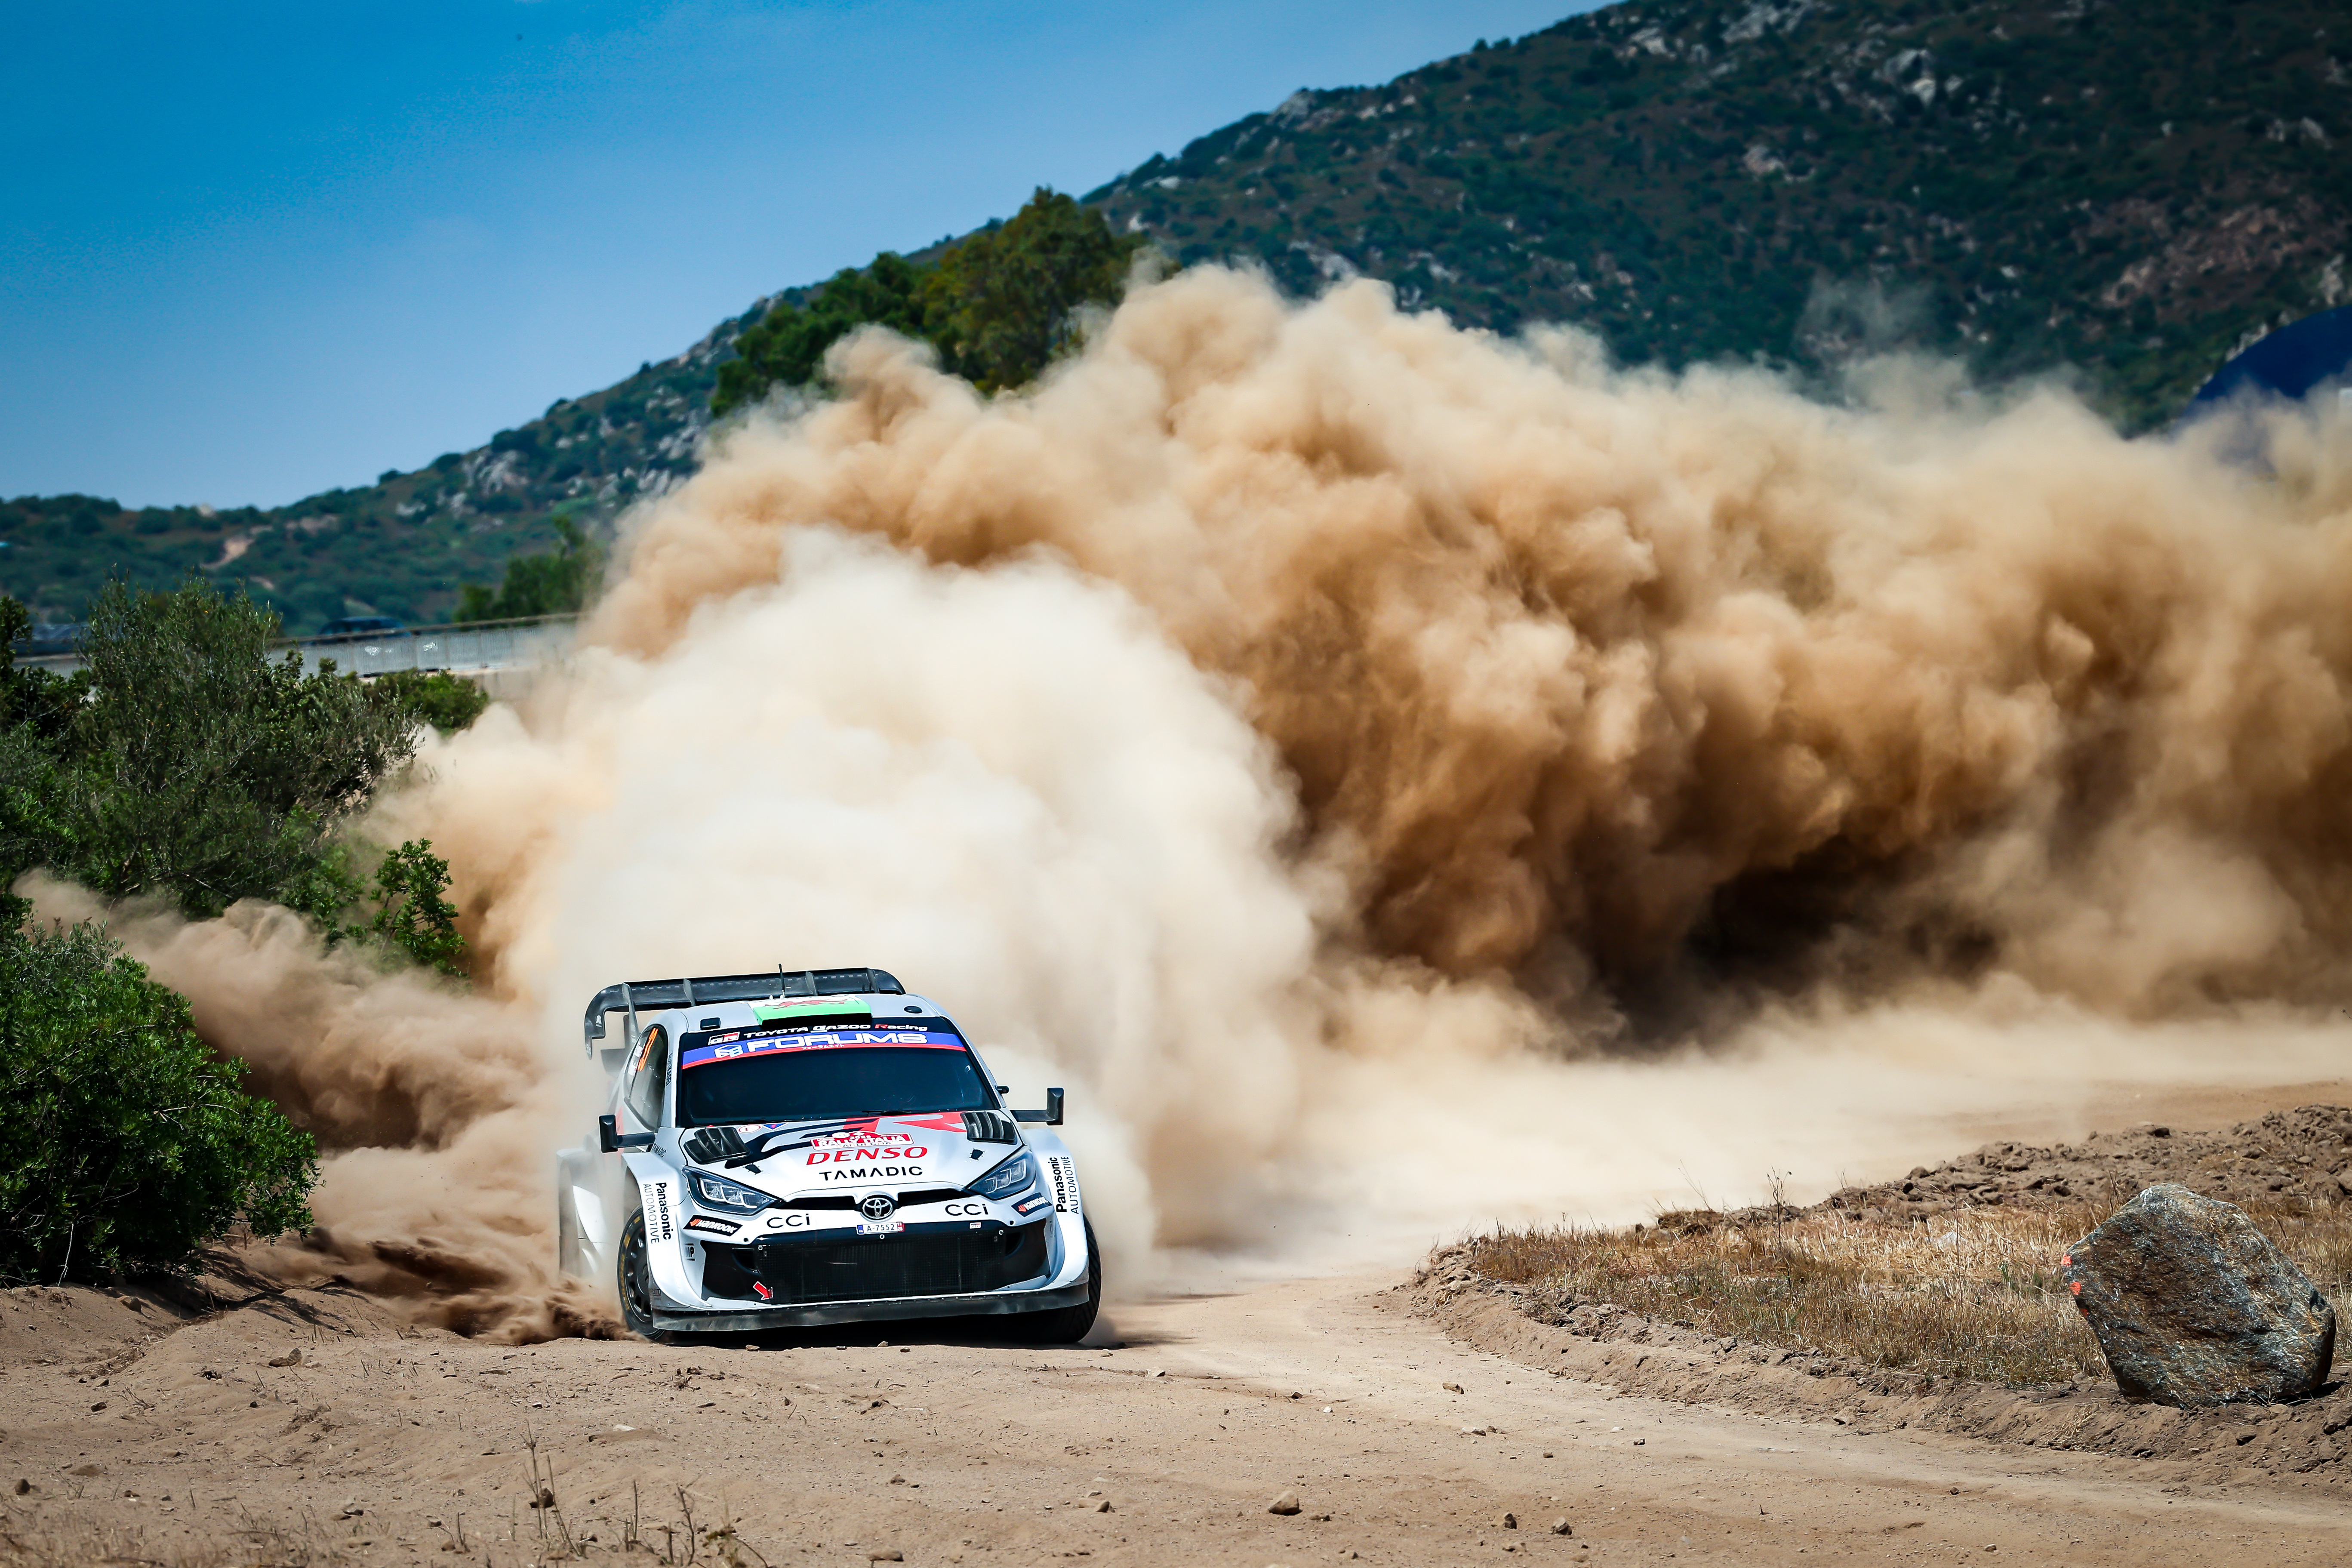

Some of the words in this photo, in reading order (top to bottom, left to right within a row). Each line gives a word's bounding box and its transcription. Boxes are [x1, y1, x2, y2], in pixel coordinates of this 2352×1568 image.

[744, 1027, 809, 1038] TOYOTA
[747, 1032, 927, 1052] FORUM8
[818, 1139, 859, 1147] RALLY
[806, 1146, 928, 1165] DENSO
[819, 1166, 923, 1181] TAMADIC
[1048, 1157, 1067, 1212] Panasonic
[1061, 1156, 1079, 1214] AUTOMOTIVE
[643, 1184, 659, 1244] AUTOMOTIVE
[656, 1182, 673, 1240] Panasonic
